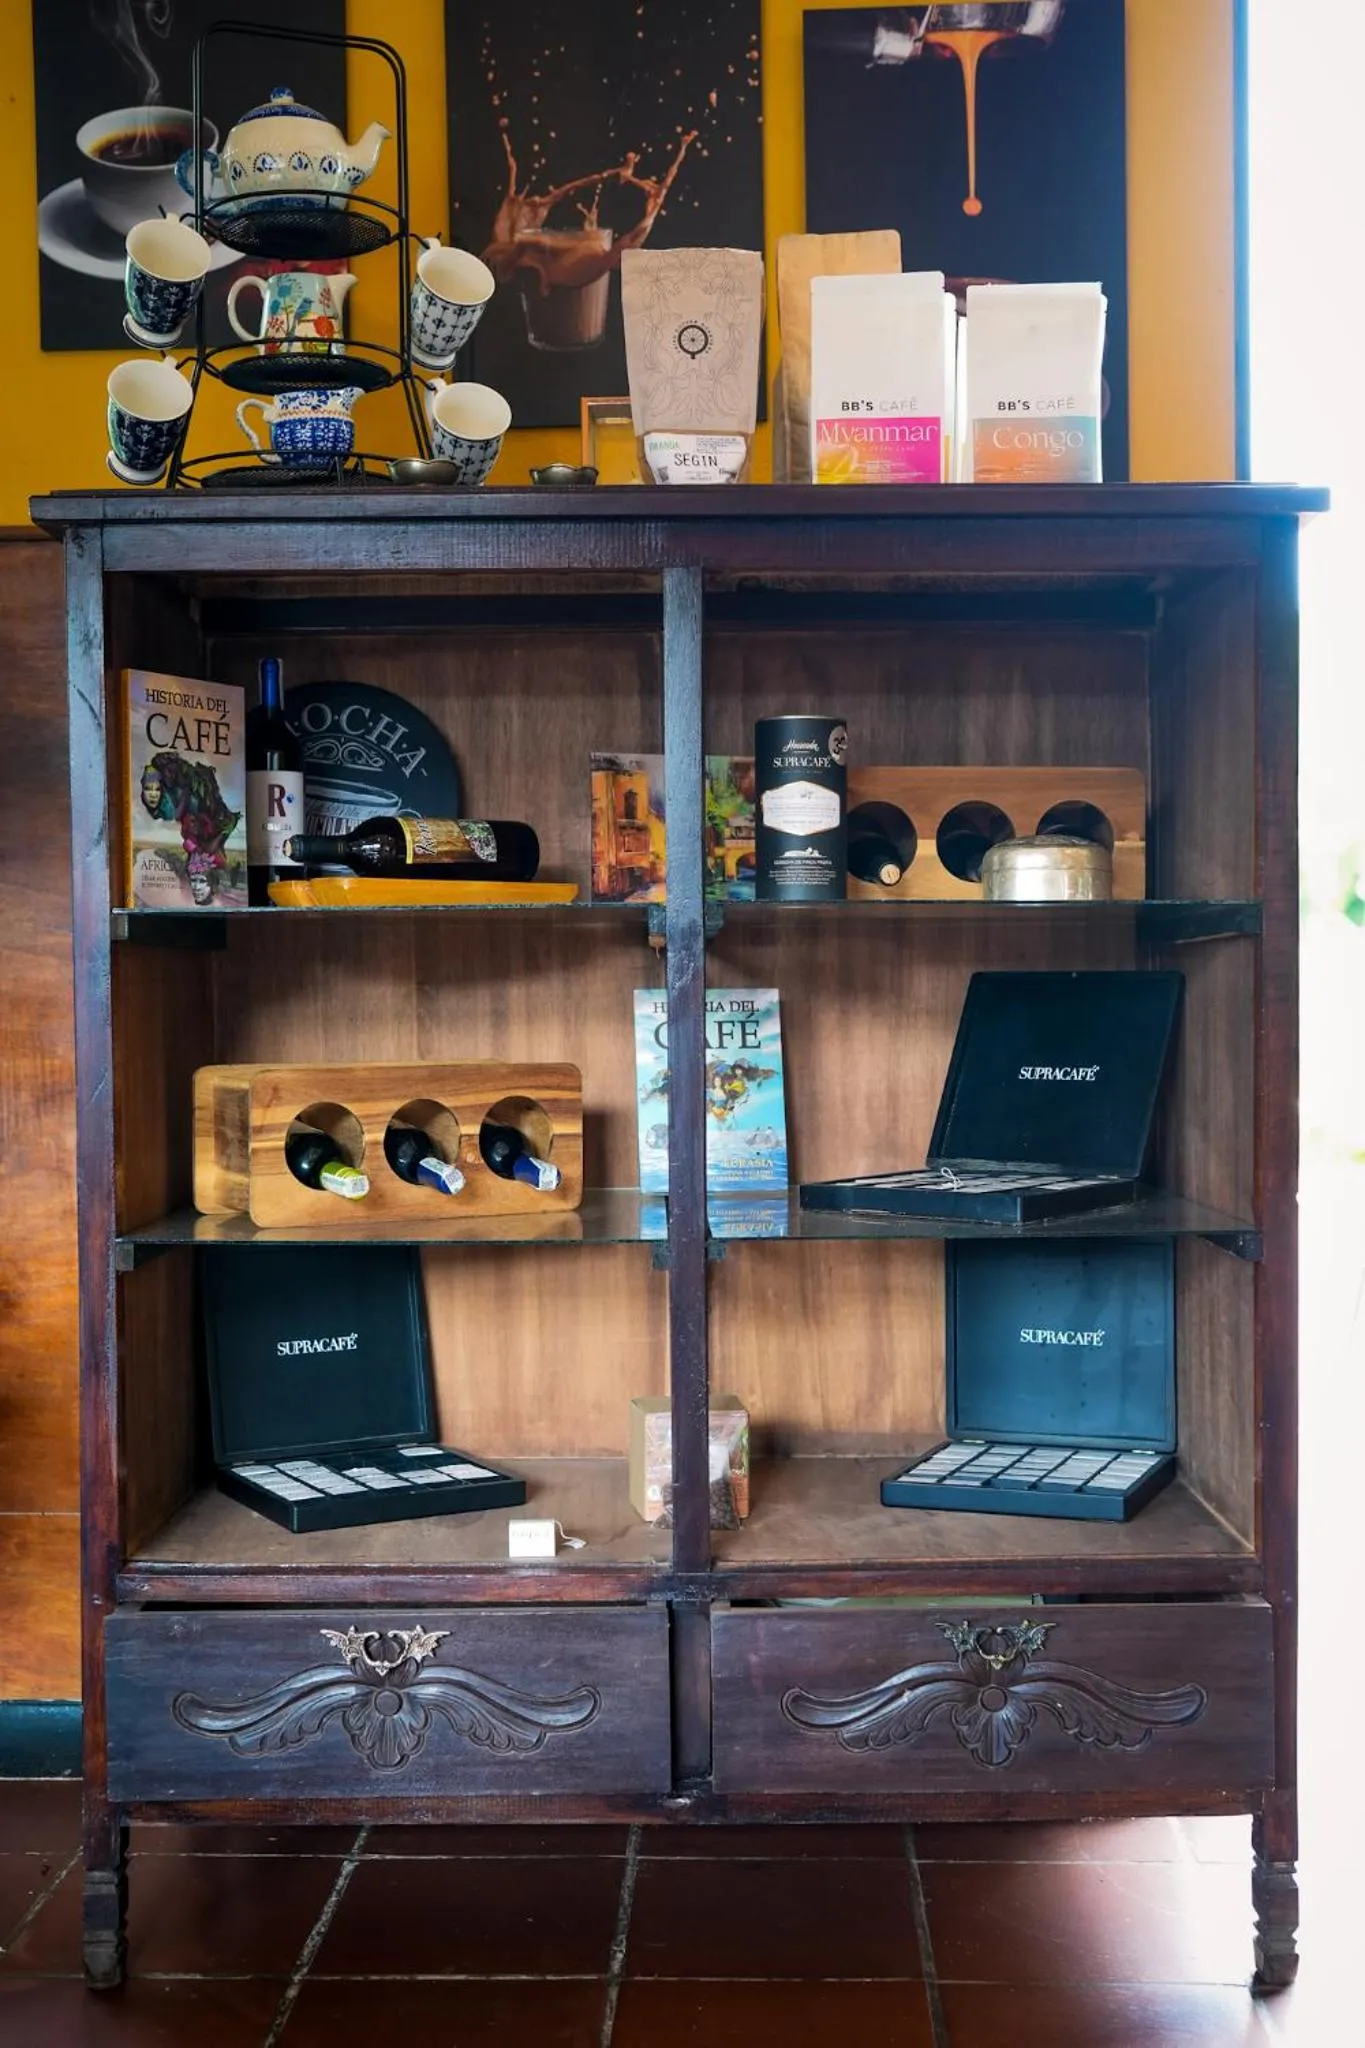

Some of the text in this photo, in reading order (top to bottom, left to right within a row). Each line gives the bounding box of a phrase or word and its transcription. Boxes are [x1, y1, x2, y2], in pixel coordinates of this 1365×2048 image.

[841, 396, 918, 412] BB'S CAFÉ
[997, 397, 1076, 411] BB'S CAFÉ
[820, 422, 938, 448] Myanmar
[993, 427, 1084, 457] Congo
[145, 688, 230, 714] HISTORIA DEL
[146, 713, 232, 756] CAFÉ
[729, 1000, 760, 1013] DEL
[653, 1012, 762, 1050] CFÉ
